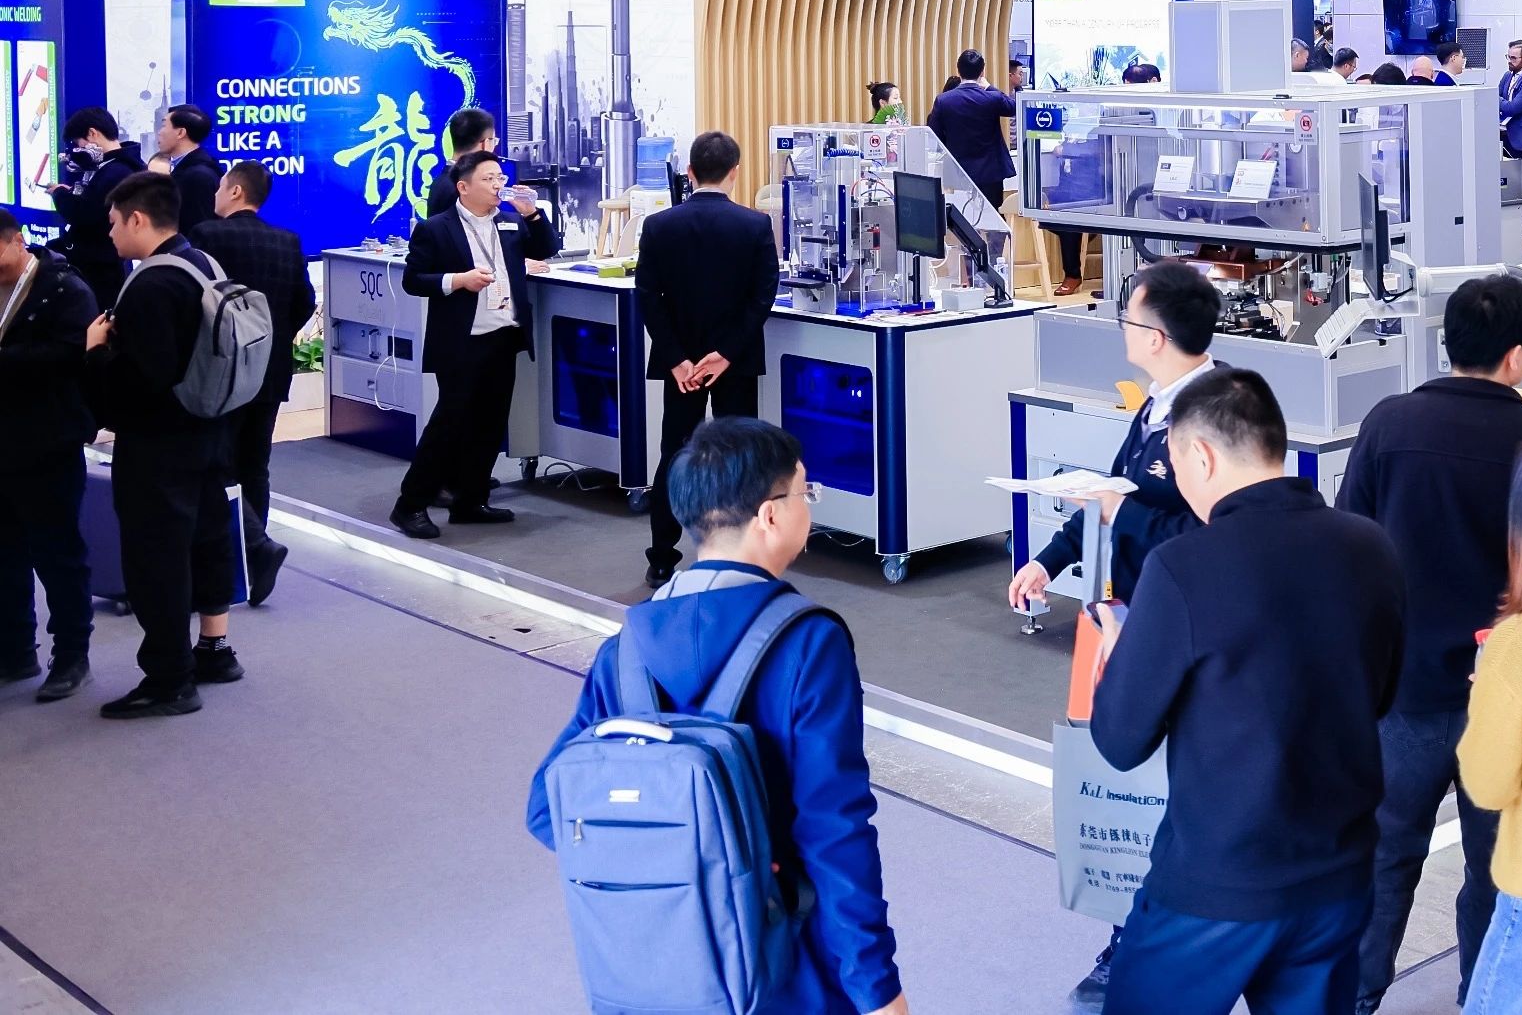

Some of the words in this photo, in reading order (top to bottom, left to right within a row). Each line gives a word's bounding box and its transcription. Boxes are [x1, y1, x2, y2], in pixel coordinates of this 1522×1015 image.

[14, 6, 41, 22] WELDING
[216, 75, 361, 99] CONNECTIONS
[216, 103, 307, 125] STRONG
[217, 131, 261, 152] LIKE
[265, 130, 282, 151] A
[360, 270, 383, 301] SQC
